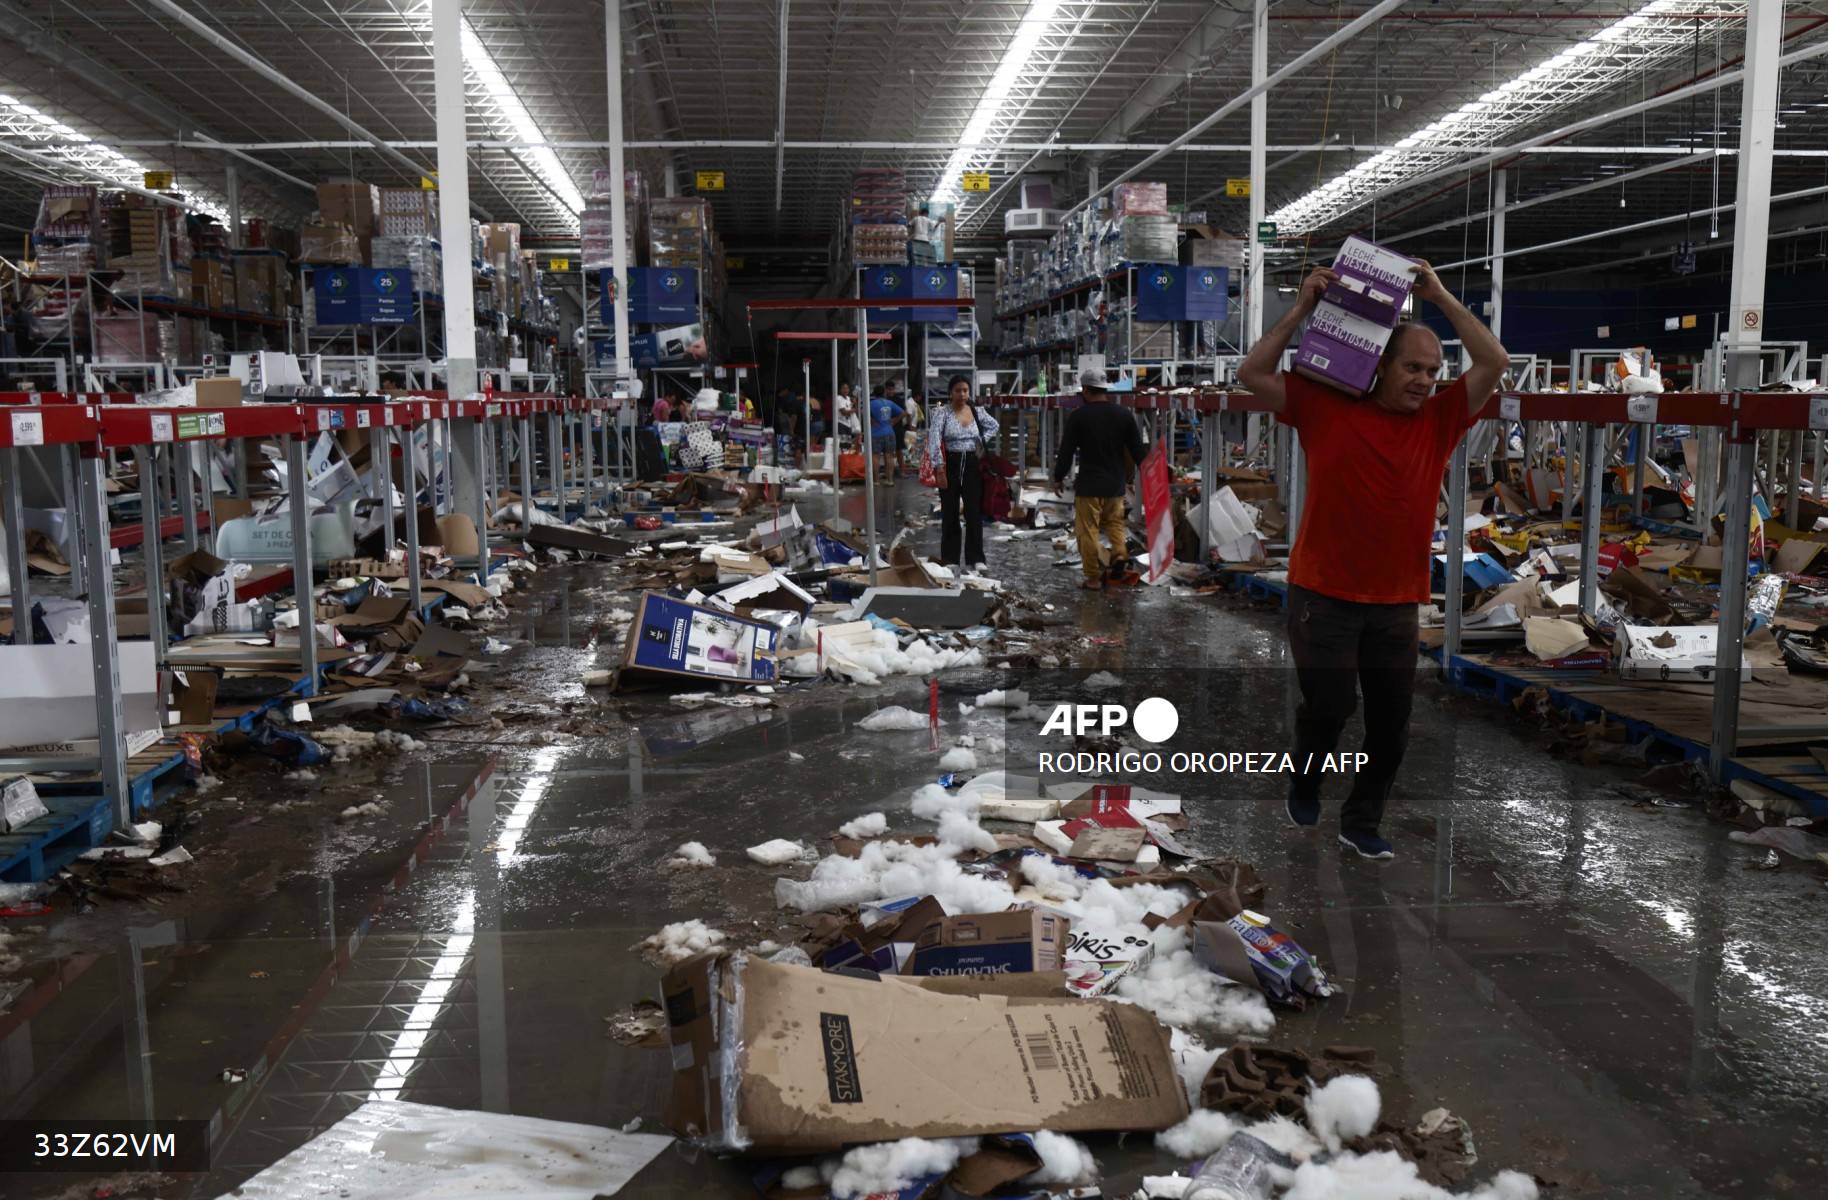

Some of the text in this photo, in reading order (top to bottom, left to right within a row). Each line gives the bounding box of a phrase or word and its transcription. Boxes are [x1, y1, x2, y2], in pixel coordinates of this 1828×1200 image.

[1347, 246, 1376, 264] LECHE
[1343, 257, 1409, 290] DESLACTOSADA
[331, 278, 342, 287] 26
[380, 278, 392, 287] 25
[666, 277, 677, 286] 23
[883, 276, 895, 286] 22
[931, 276, 941, 285] 21
[1157, 276, 1168, 285] 20
[1204, 276, 1213, 285] 19
[1317, 309, 1345, 327] LECHE
[1312, 317, 1377, 354] DESLACTOSADA
[252, 531, 269, 540] SET
[272, 531, 284, 540] DE
[13, 743, 75, 753] DELUXE
[827, 1014, 853, 1102] STAKMORE
